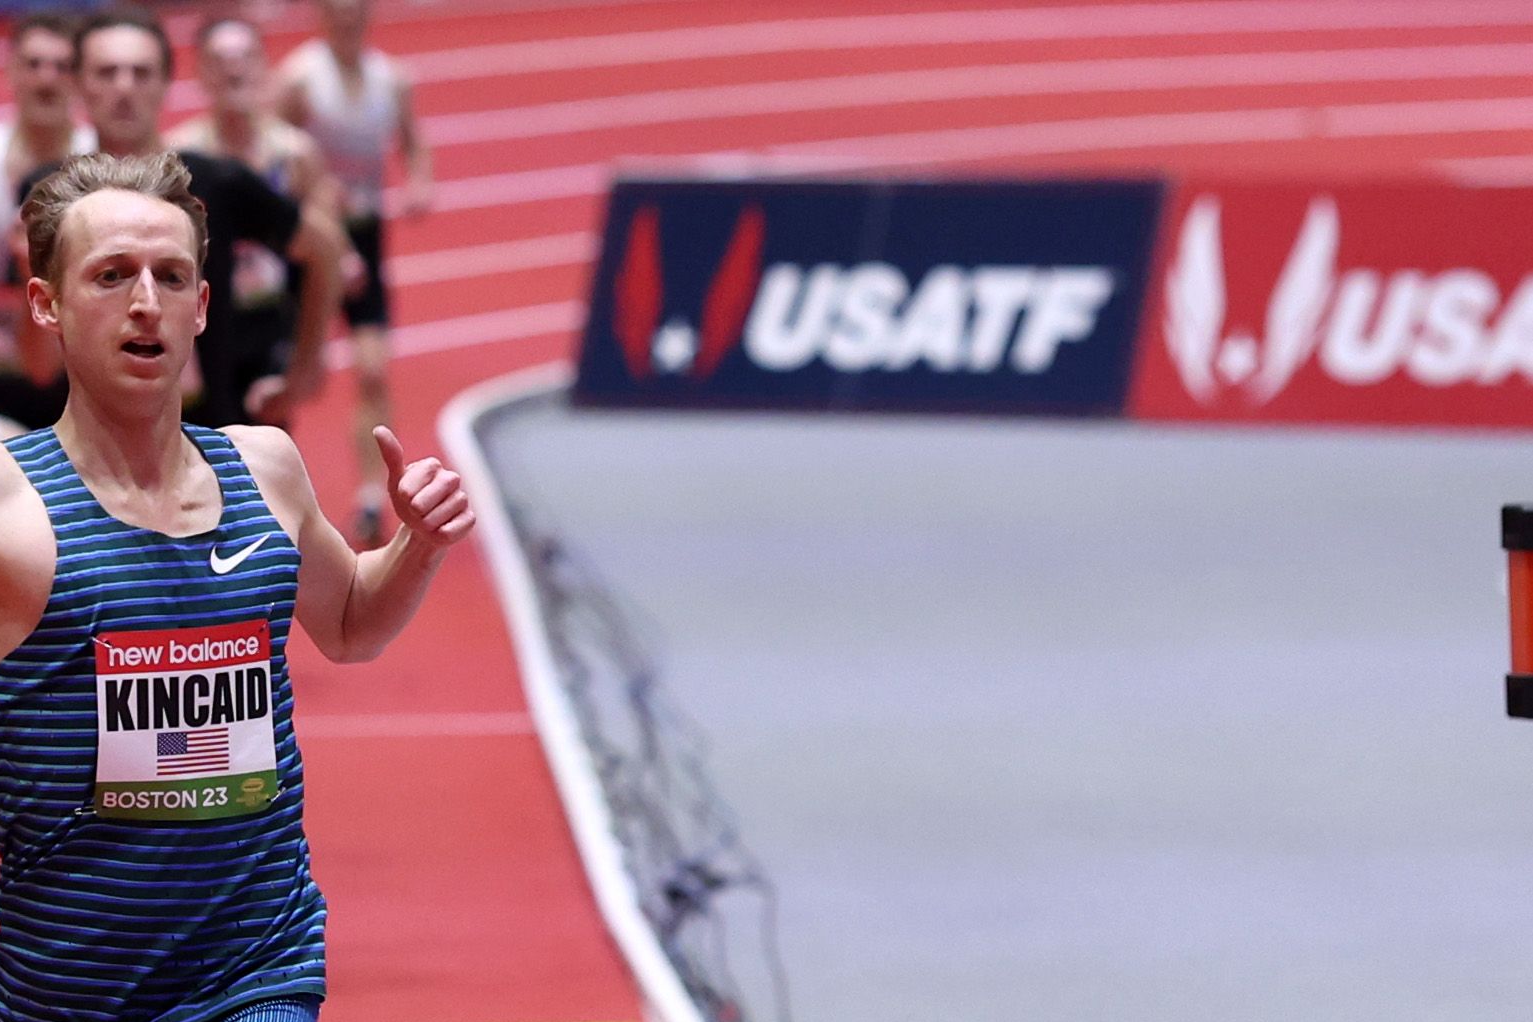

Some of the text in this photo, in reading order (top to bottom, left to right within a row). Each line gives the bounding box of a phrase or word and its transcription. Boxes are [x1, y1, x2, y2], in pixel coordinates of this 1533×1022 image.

[743, 261, 1116, 373] USATF
[109, 636, 260, 667] new balance
[105, 667, 268, 732] KINCAID
[102, 787, 229, 809] BOSTON 23
